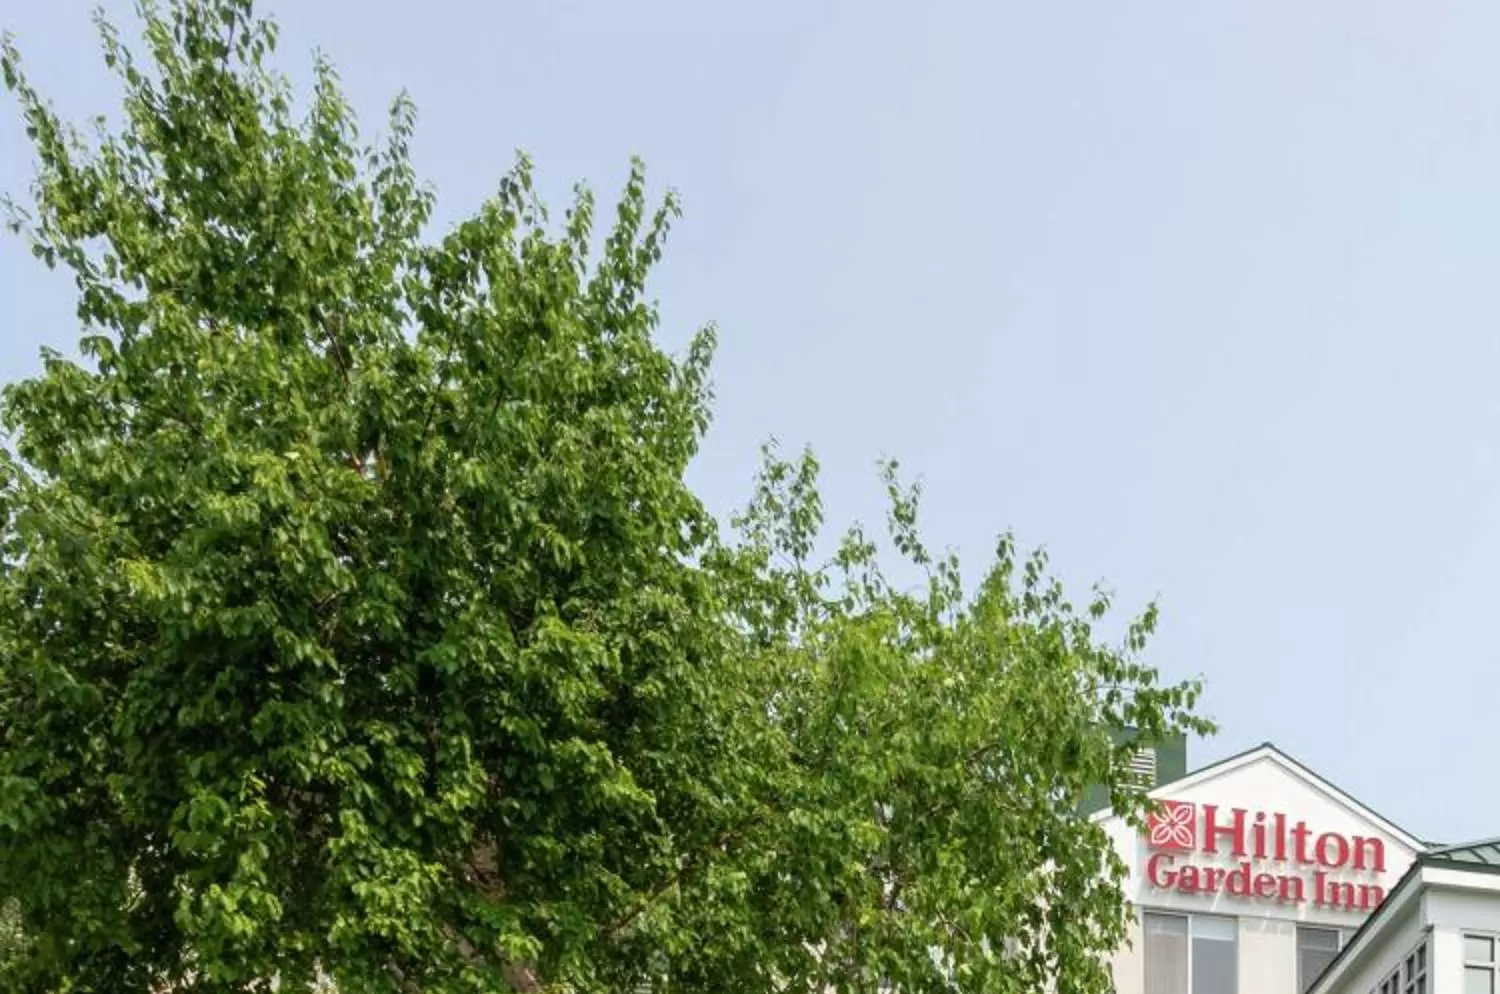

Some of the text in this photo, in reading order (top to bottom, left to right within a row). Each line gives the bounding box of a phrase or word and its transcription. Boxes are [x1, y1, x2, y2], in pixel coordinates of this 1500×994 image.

[1202, 804, 1387, 872] Hilton
[1148, 852, 1385, 910] Garden Inn
